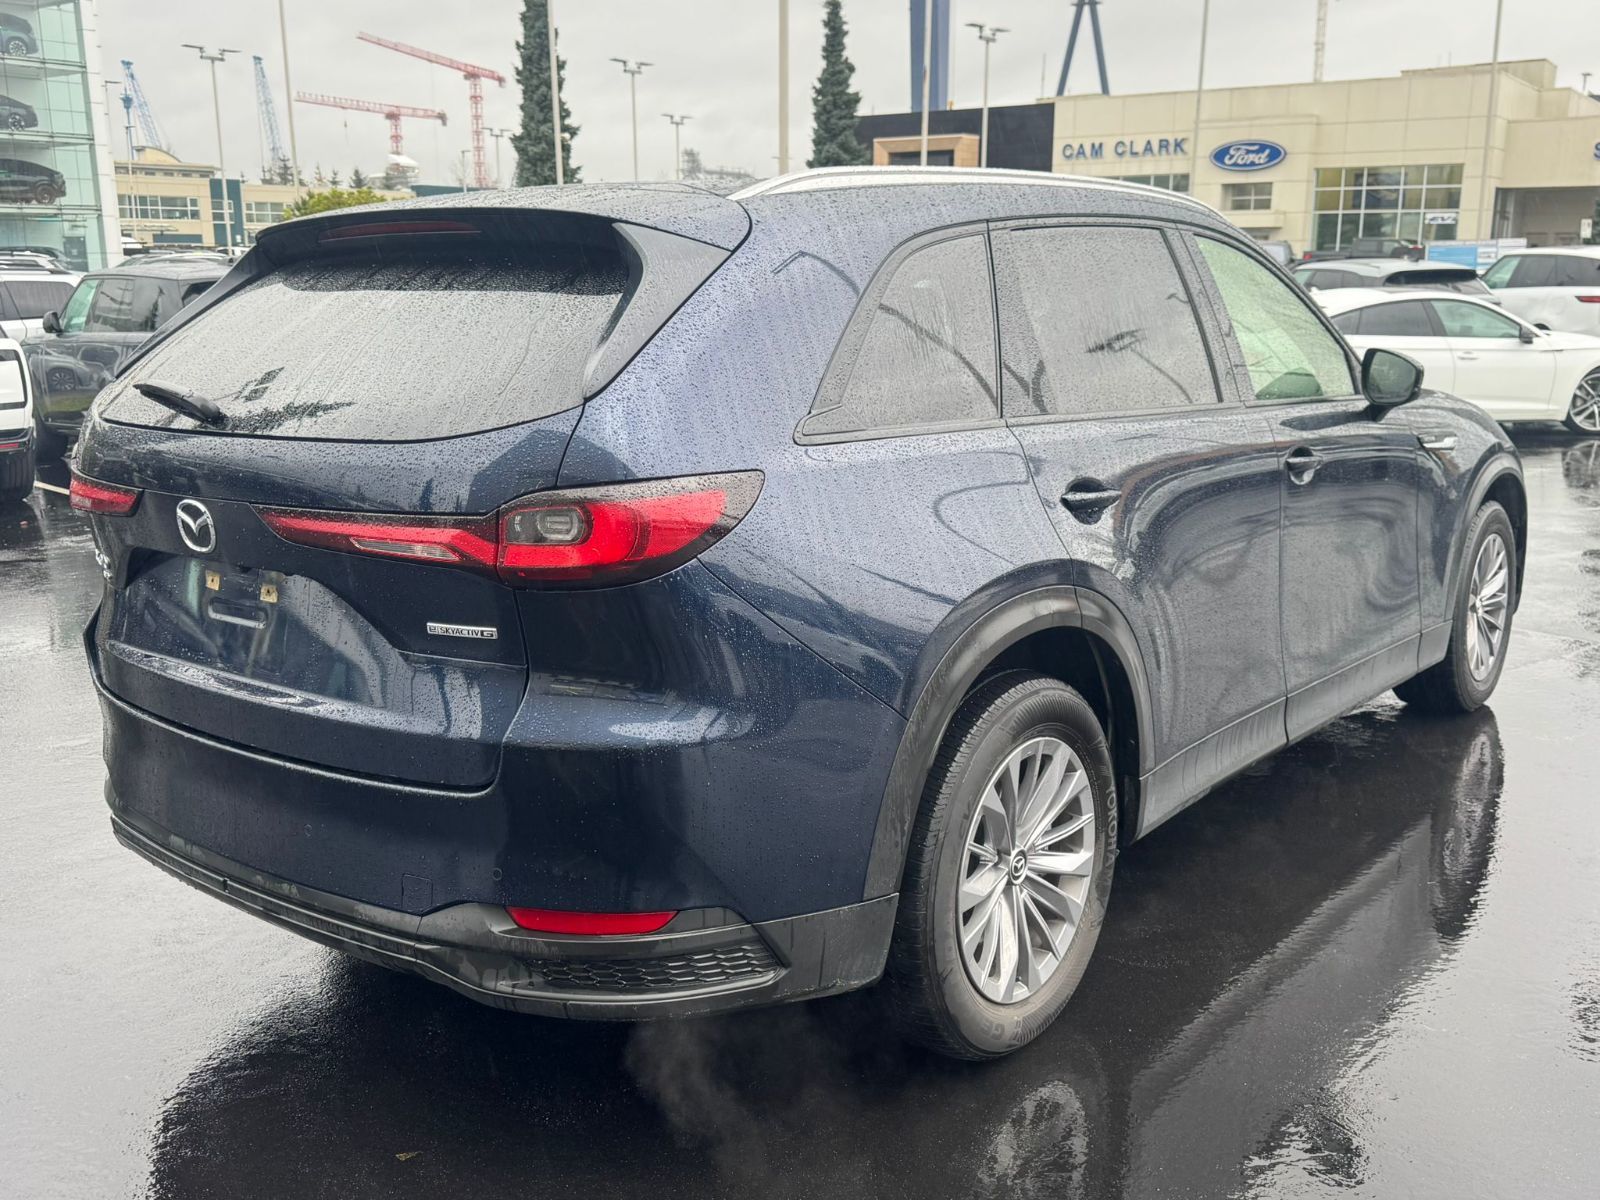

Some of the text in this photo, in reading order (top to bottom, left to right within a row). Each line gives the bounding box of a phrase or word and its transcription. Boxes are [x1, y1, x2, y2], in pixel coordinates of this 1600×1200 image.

[1062, 137, 1188, 160] CAM CLARK
[1224, 145, 1269, 165] Ford
